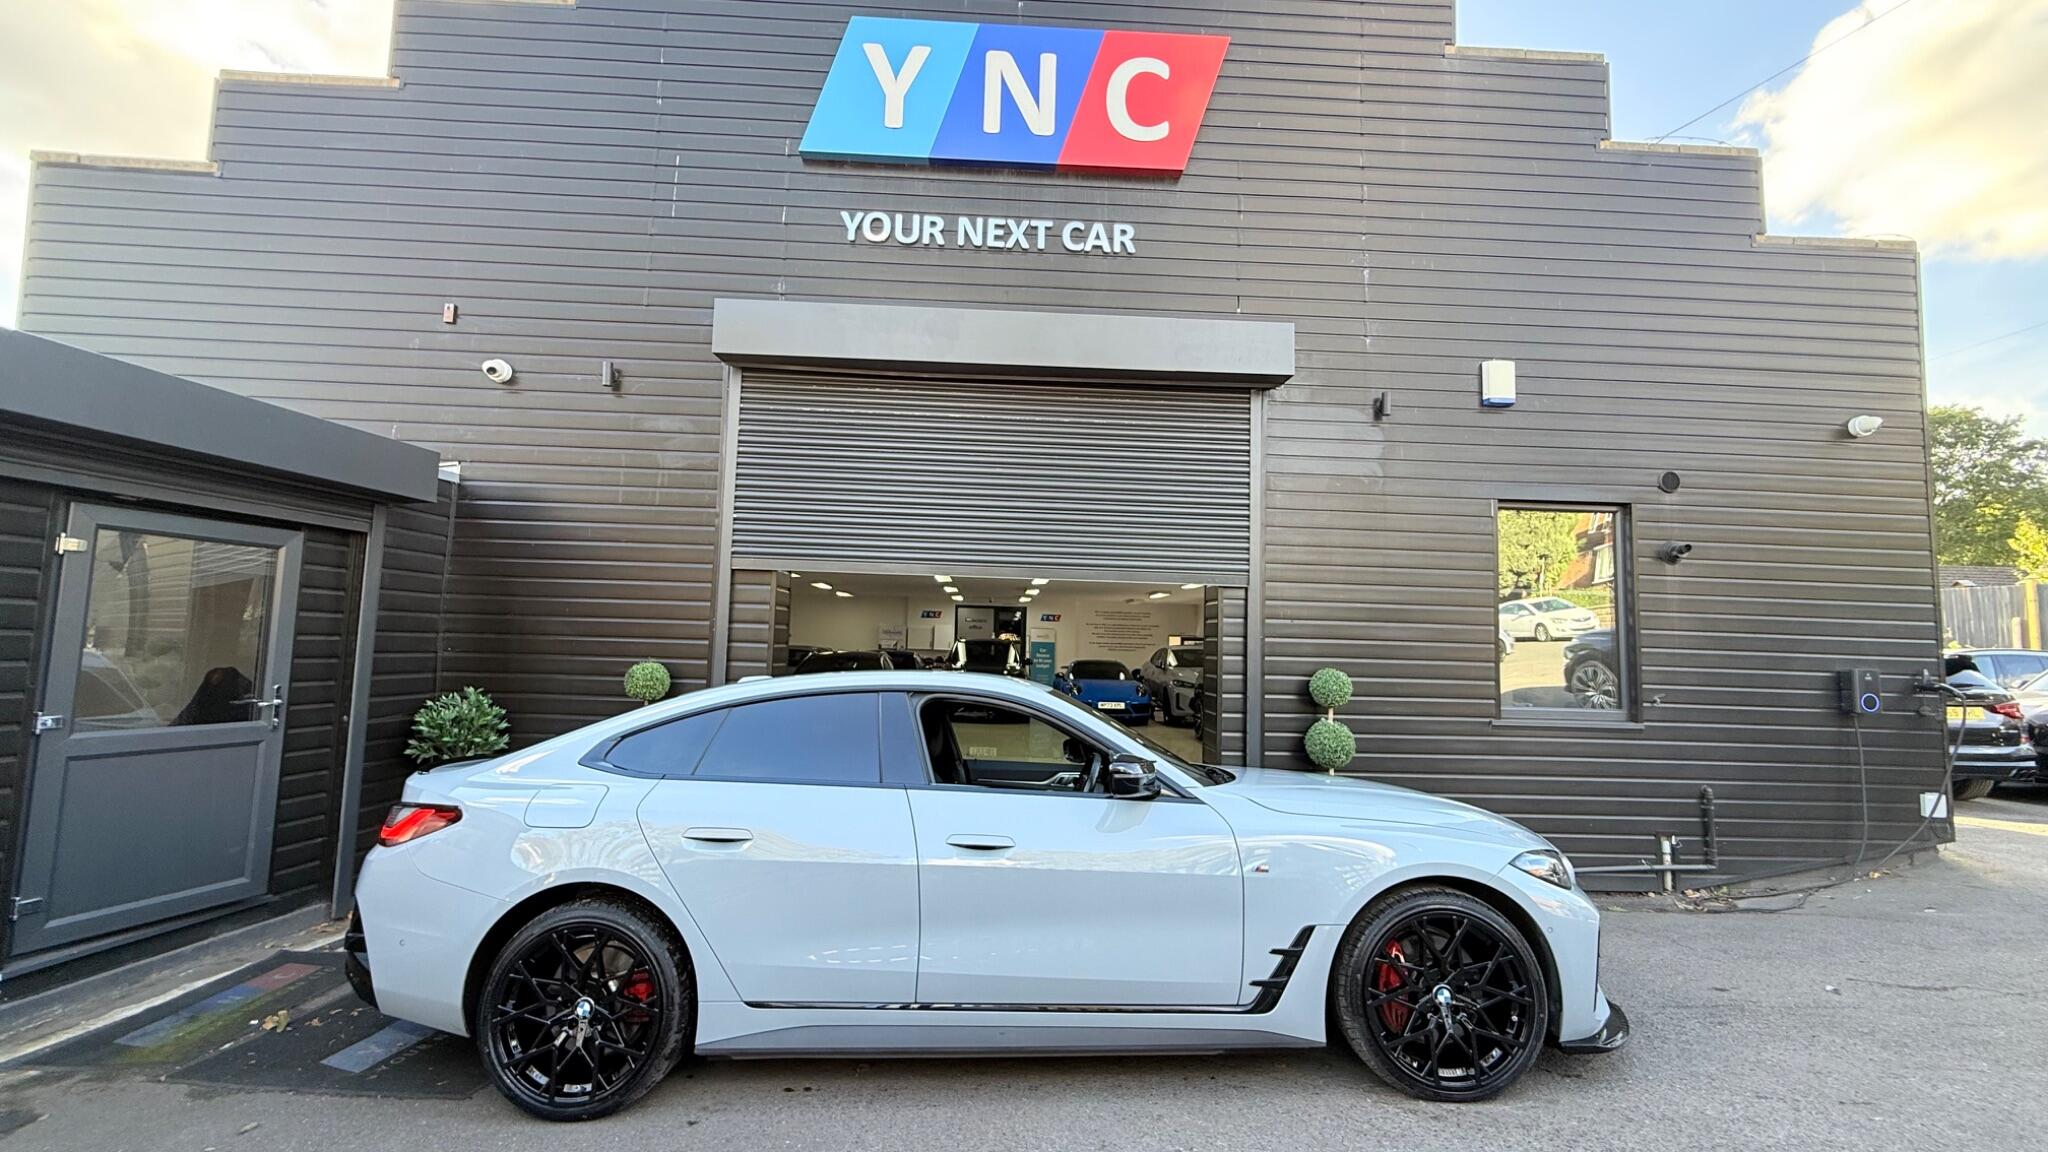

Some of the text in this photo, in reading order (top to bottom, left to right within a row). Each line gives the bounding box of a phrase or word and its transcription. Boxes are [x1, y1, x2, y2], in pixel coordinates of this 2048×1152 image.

[862, 42, 1170, 142] YNC
[840, 211, 1136, 254] YOUR NEXT CAR
